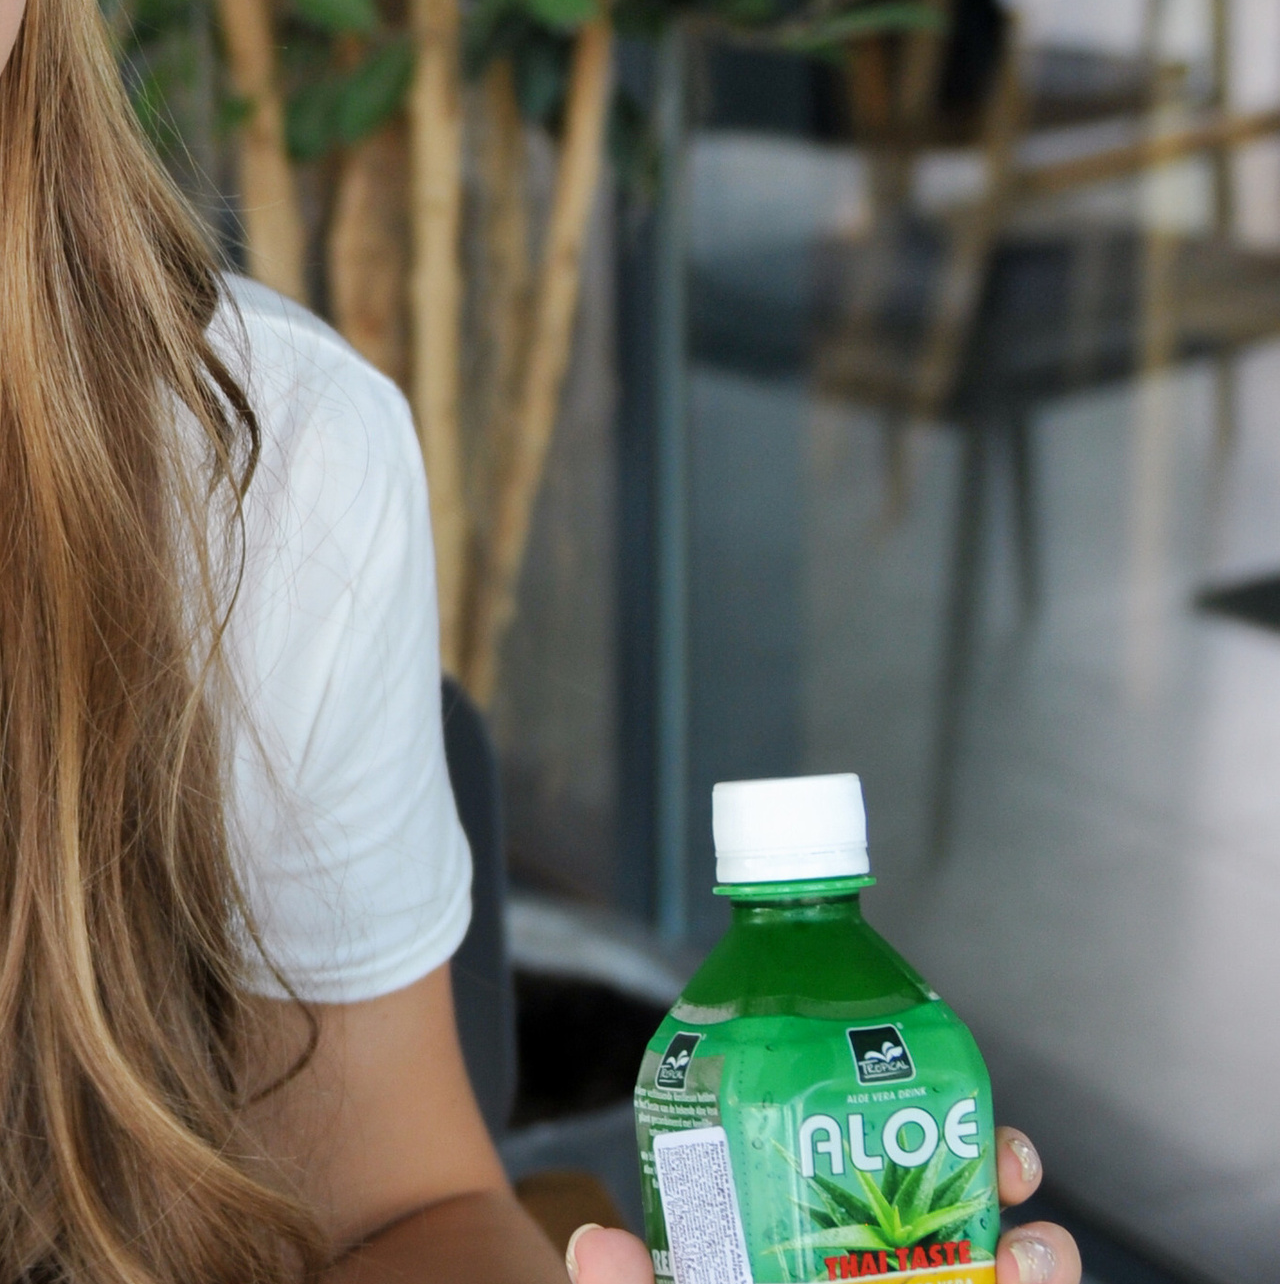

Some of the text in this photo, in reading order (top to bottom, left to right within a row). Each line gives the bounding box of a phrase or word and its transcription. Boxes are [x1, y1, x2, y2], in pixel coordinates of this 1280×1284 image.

[858, 1059, 910, 1075] TROPICAL
[847, 1086, 927, 1104] ALOE VERA DRINK
[798, 1098, 980, 1179] ALOE
[824, 1239, 973, 1281] THAI TASTE
